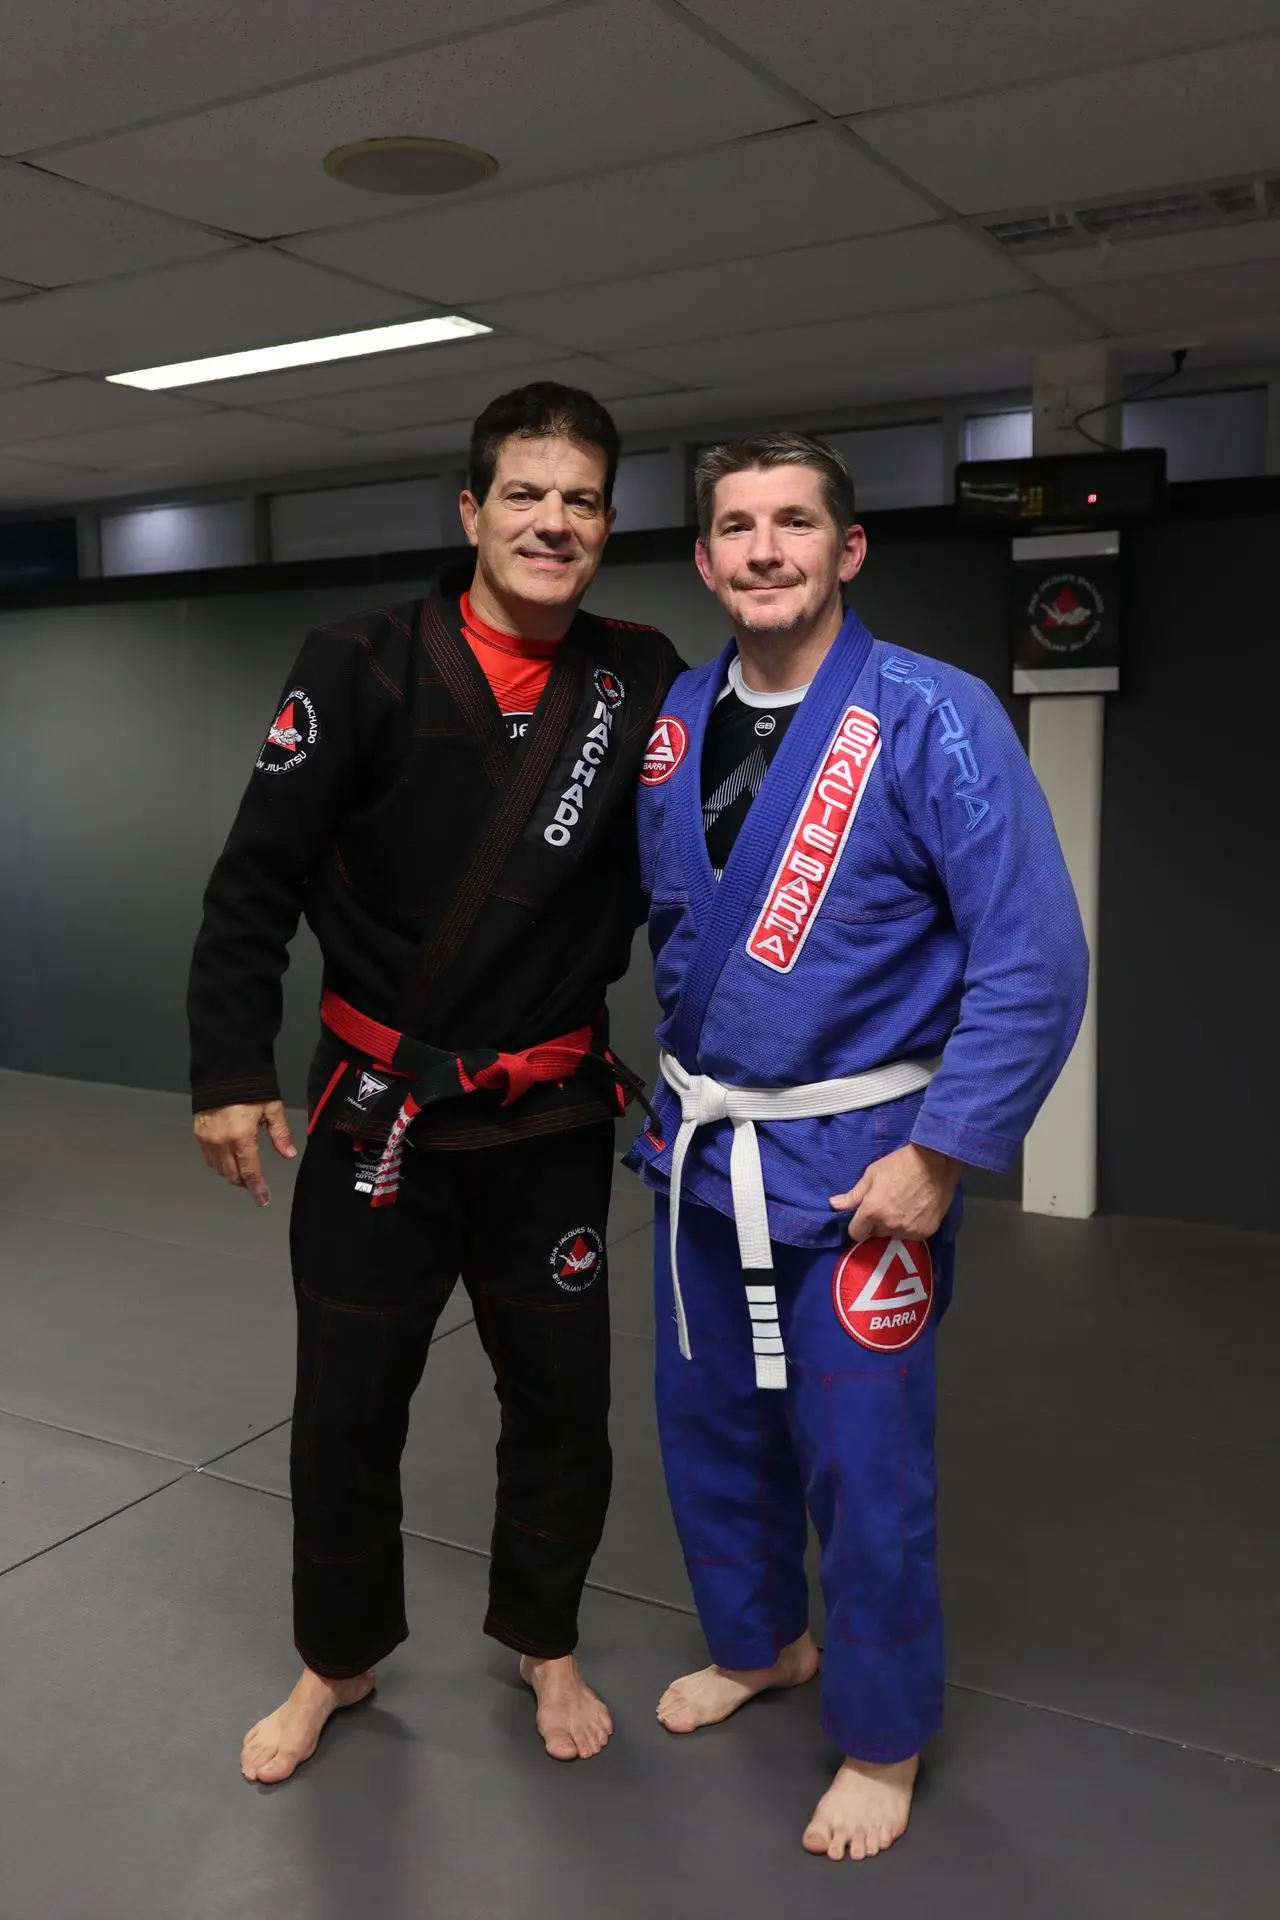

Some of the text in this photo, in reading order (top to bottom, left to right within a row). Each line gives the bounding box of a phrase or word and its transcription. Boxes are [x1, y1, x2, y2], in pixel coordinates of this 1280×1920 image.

[302, 697, 319, 744] MACHADO
[756, 721, 773, 731] GB
[264, 750, 307, 772] JIU-JITSU
[881, 655, 990, 832] BARRA
[543, 700, 614, 847] MACHADO
[642, 762, 667, 771] BARRA
[755, 716, 880, 961] GRACIE BARRA
[549, 1247, 559, 1266] JEAN
[558, 1226, 586, 1246] JACQUES
[869, 1309, 917, 1331] BARRA
